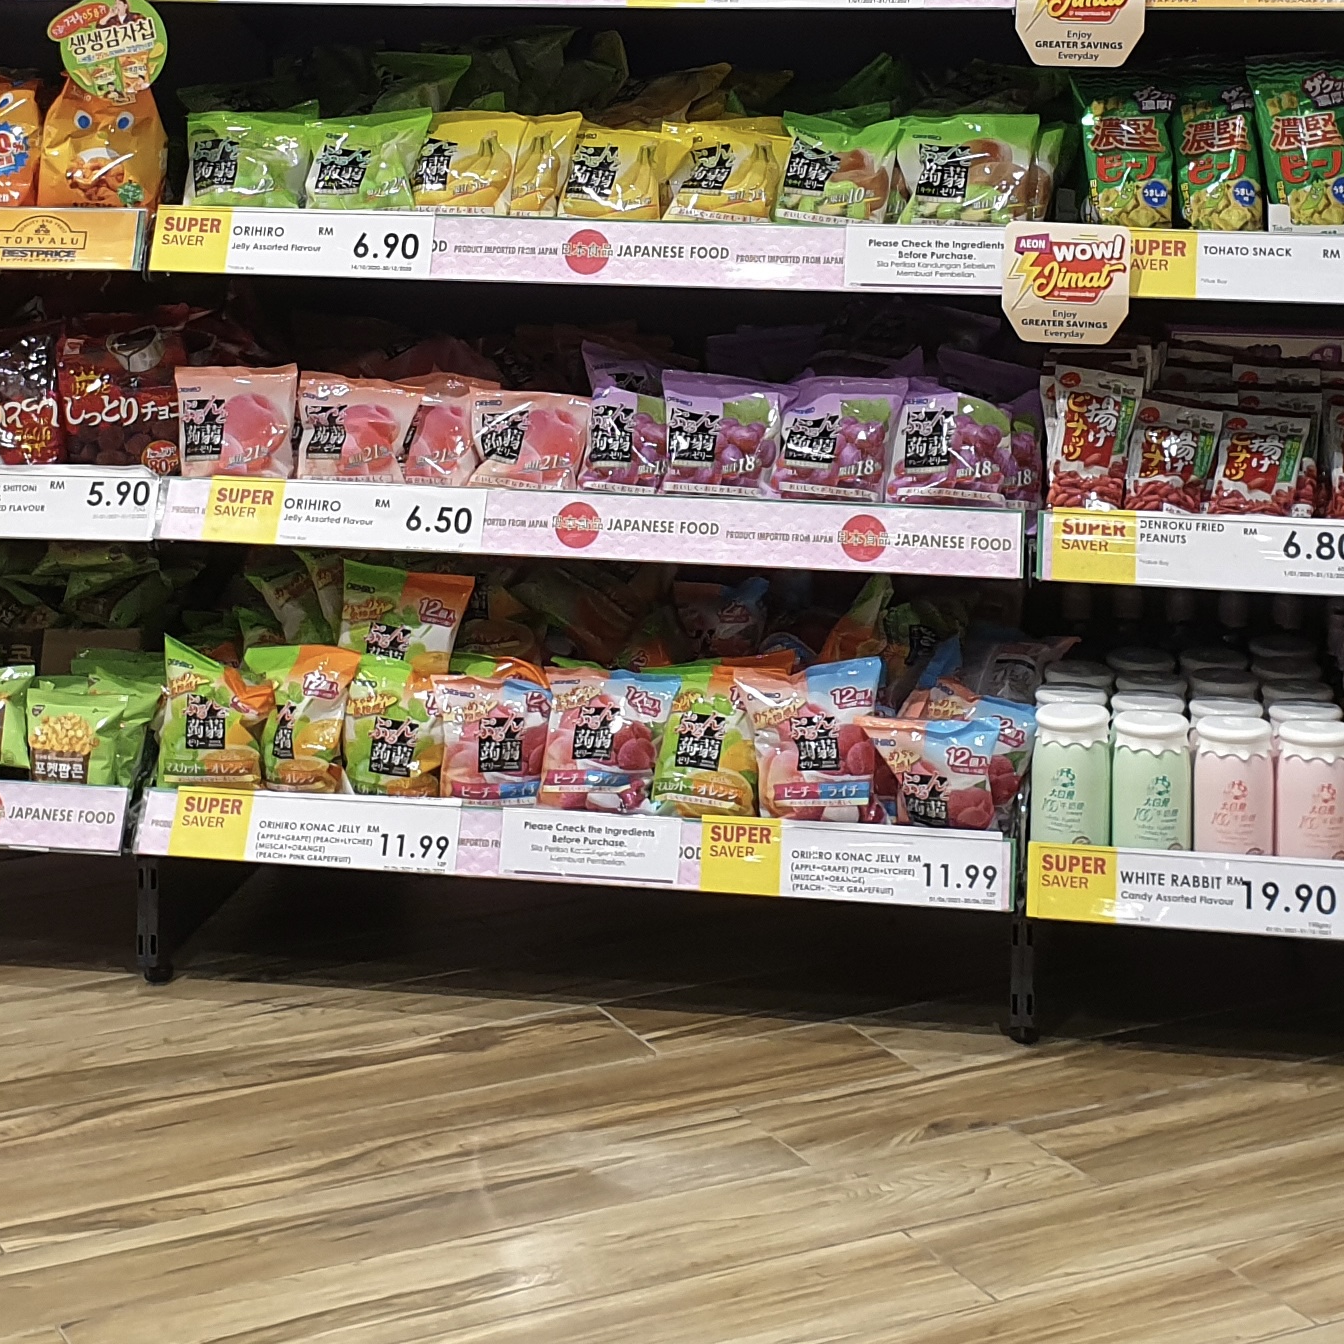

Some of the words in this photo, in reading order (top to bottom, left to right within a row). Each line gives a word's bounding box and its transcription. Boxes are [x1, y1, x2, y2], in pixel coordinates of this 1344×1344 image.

[233, 226, 284, 237] ORIHIRO
[4, 235, 79, 246] TOPVALU
[232, 243, 250, 252] Jelly
[353, 234, 419, 259] 6.90
[618, 244, 686, 258] JAPANESE
[690, 245, 729, 259] FOOD
[1204, 246, 1250, 256] TOHATO
[1252, 247, 1292, 256] SNACK
[87, 481, 150, 507] 5.90
[285, 498, 341, 511] ORIHIRO
[406, 506, 472, 534] 6.50
[1139, 520, 1193, 532] DENROKU
[1196, 522, 1224, 532] FRIED
[1139, 533, 1187, 544] PEANUTS
[185, 797, 242, 815] SUPER
[181, 815, 224, 829] SAVER
[380, 833, 449, 860] 11.99
[1121, 872, 1165, 886] WHITE
[1170, 873, 1222, 890] RABBIT
[1242, 880, 1336, 915] 19.90
